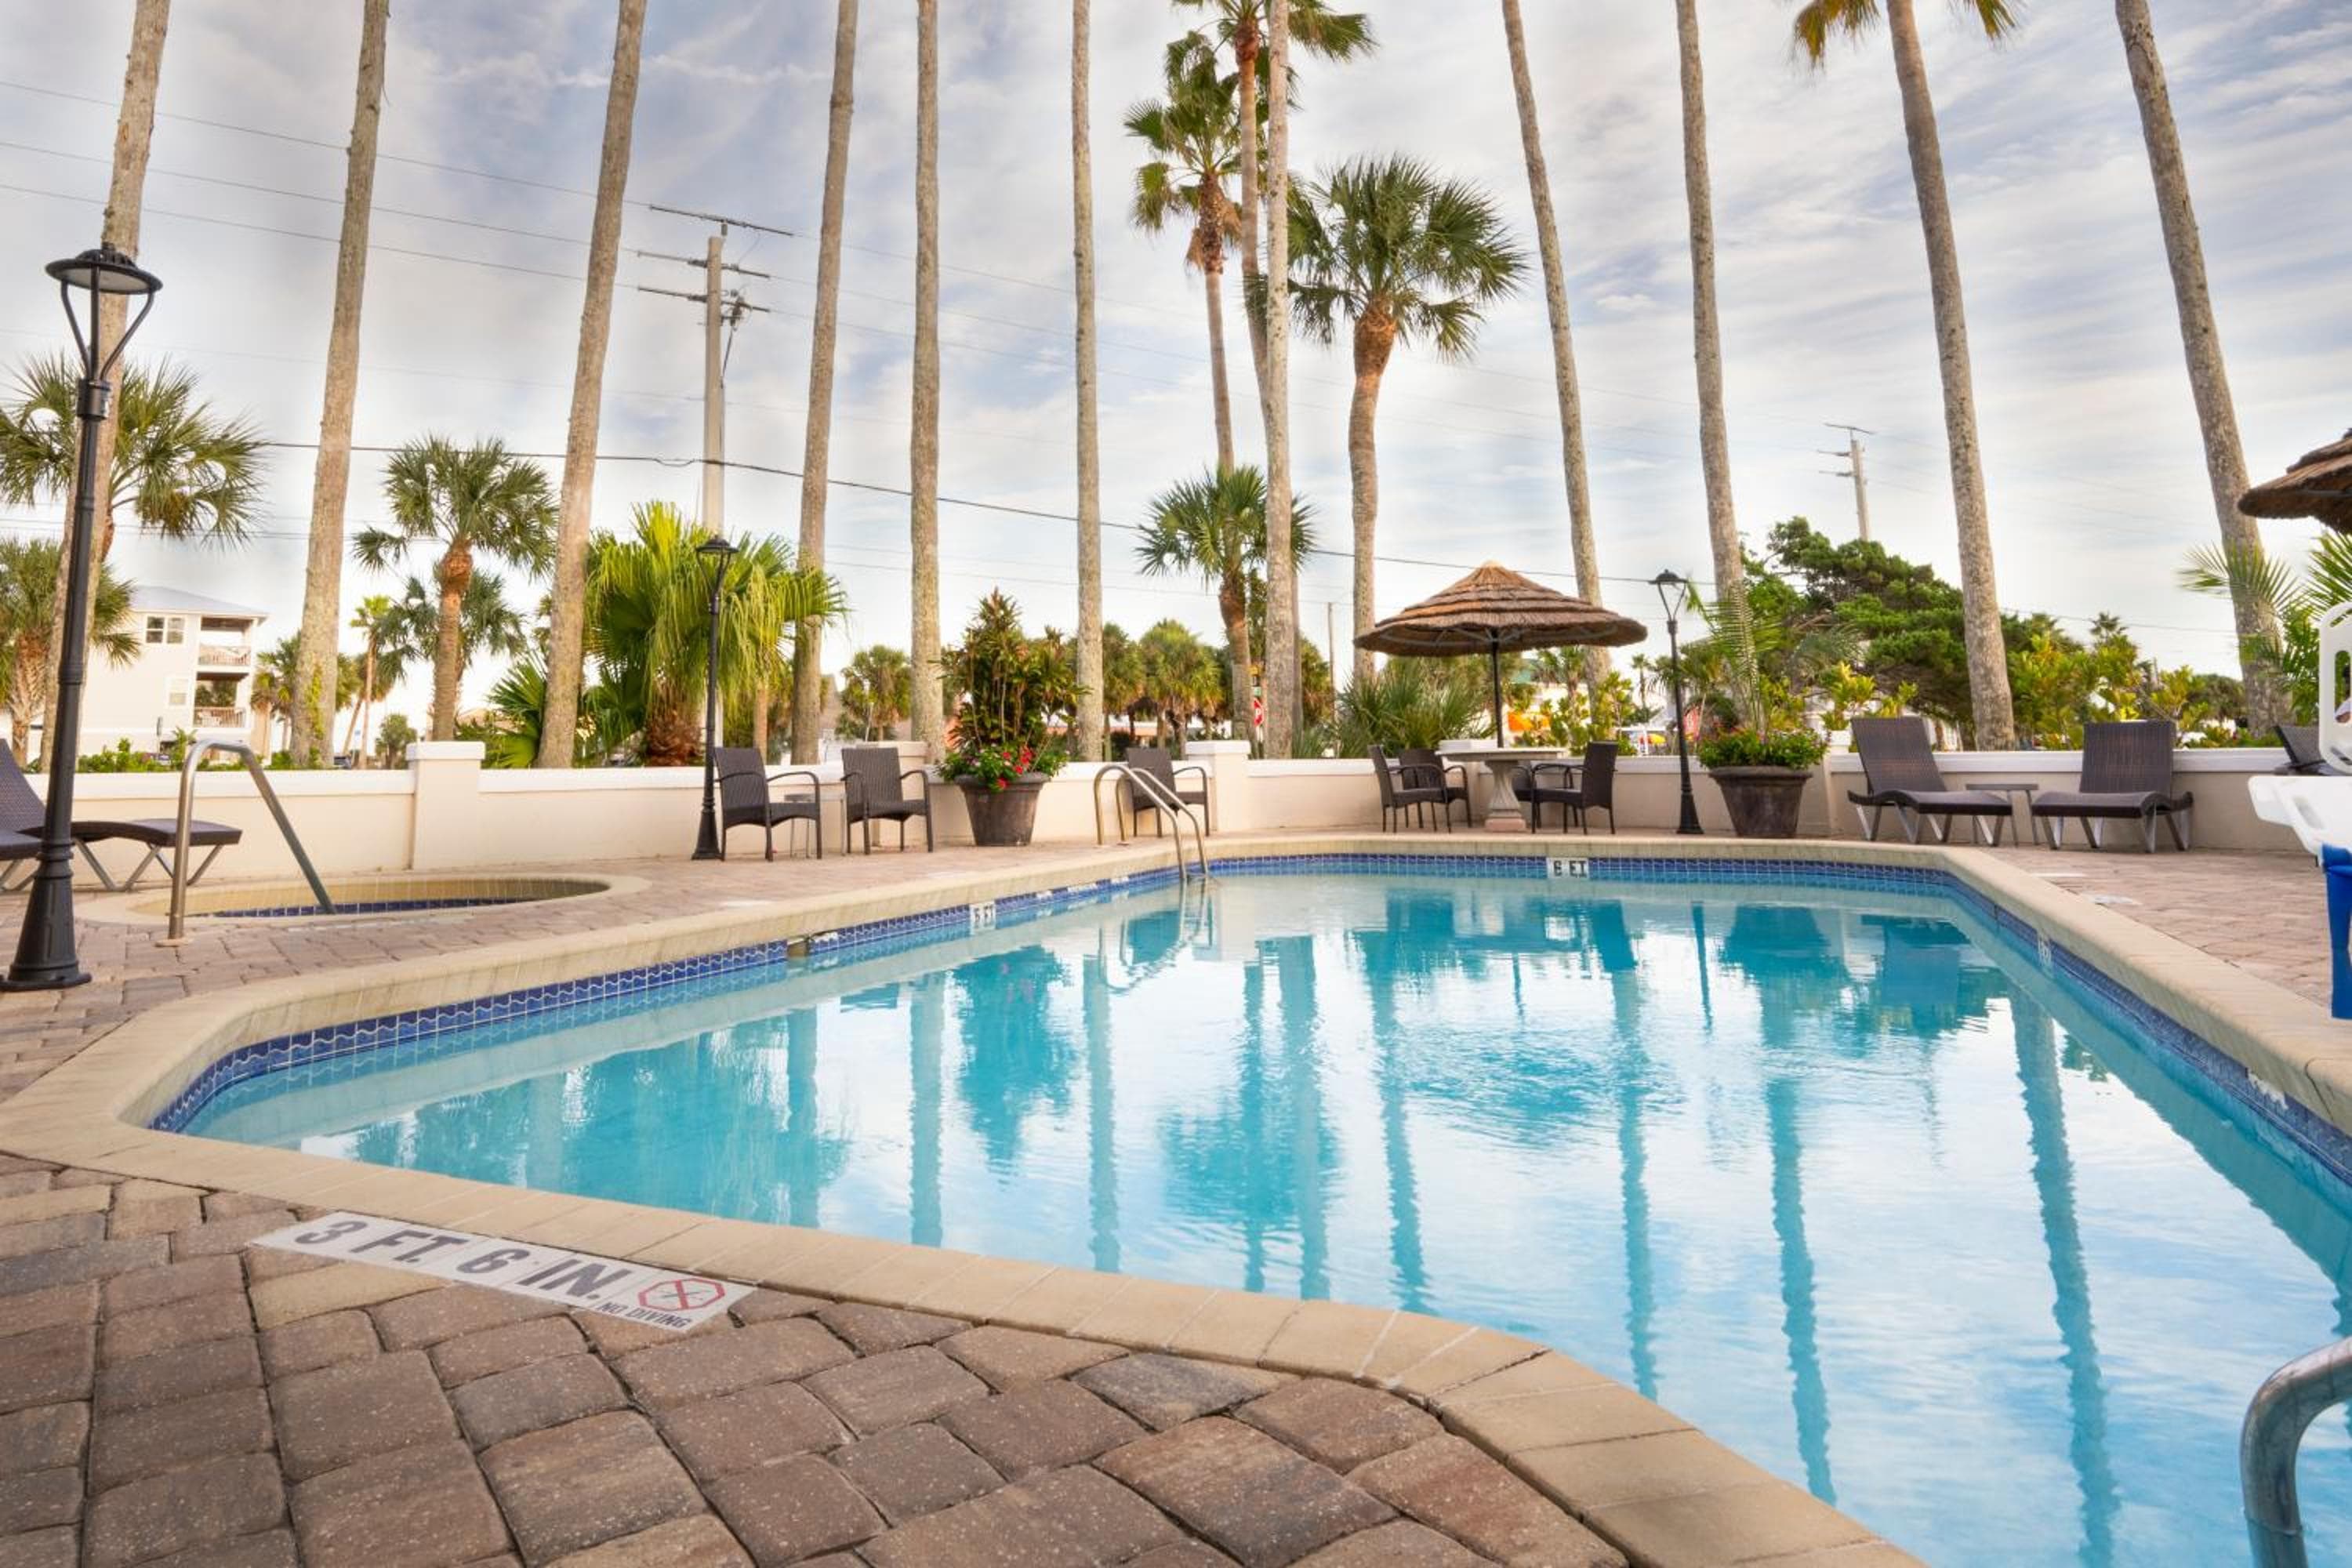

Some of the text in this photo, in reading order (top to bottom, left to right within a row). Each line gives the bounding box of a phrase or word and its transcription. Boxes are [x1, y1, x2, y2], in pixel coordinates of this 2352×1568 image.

[295, 1220, 368, 1245] 3
[456, 1248, 531, 1274] 6
[596, 1301, 691, 1328] NO DIVING
